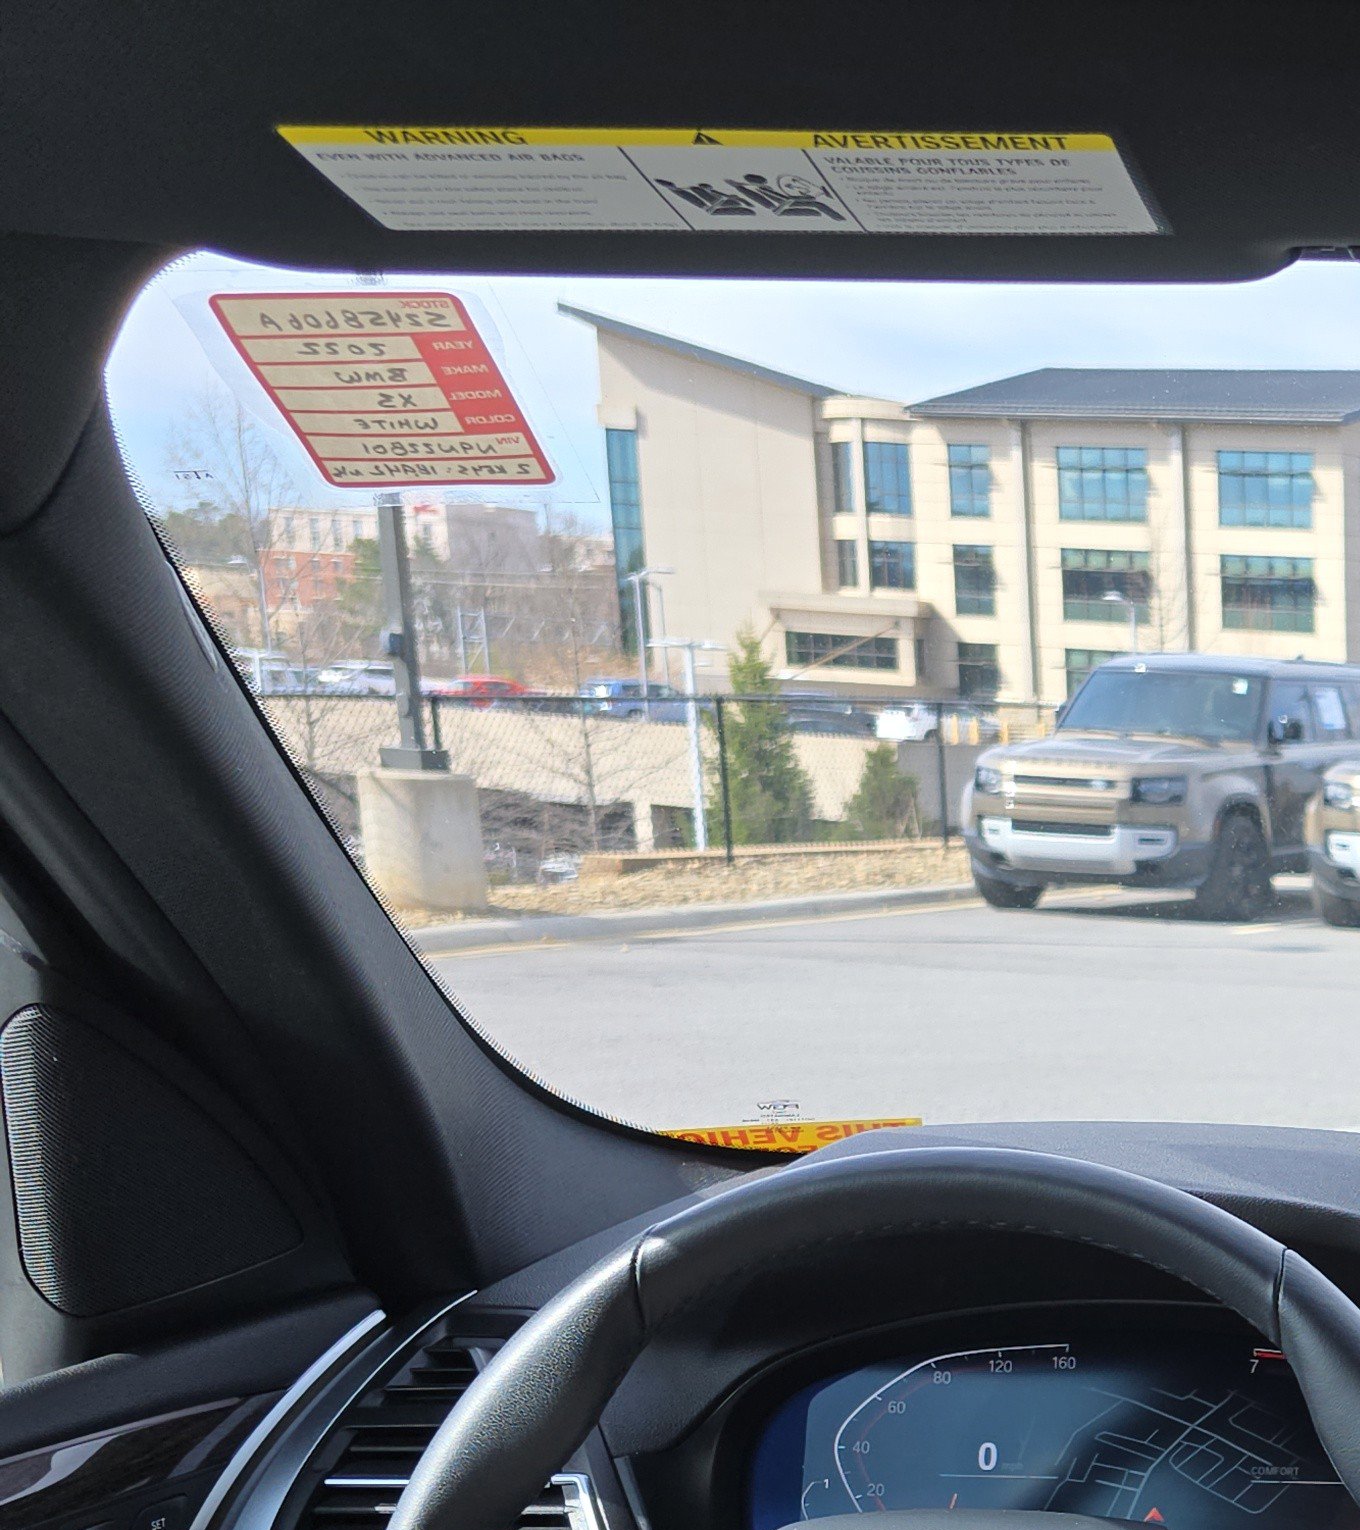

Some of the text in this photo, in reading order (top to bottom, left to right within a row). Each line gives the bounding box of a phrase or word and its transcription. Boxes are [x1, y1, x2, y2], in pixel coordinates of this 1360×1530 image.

[363, 129, 529, 146] WARNING
[813, 133, 1068, 151] AVERTISSEMENT
[364, 152, 408, 162] WITH
[415, 152, 502, 163] ADVANCED
[508, 153, 534, 163] AIR
[541, 153, 586, 163] BAGS
[899, 157, 944, 168] POUR
[988, 1359, 1013, 1374] 120
[1052, 1355, 1077, 1370] 160
[1249, 1358, 1260, 1374] 7
[932, 1370, 952, 1386] 80
[887, 1400, 907, 1415] 60
[852, 1440, 871, 1455] 40
[976, 1441, 998, 1471] 0
[1251, 1465, 1301, 1477] COMFORT
[866, 1482, 886, 1497] 20
[149, 1516, 167, 1530] SET
